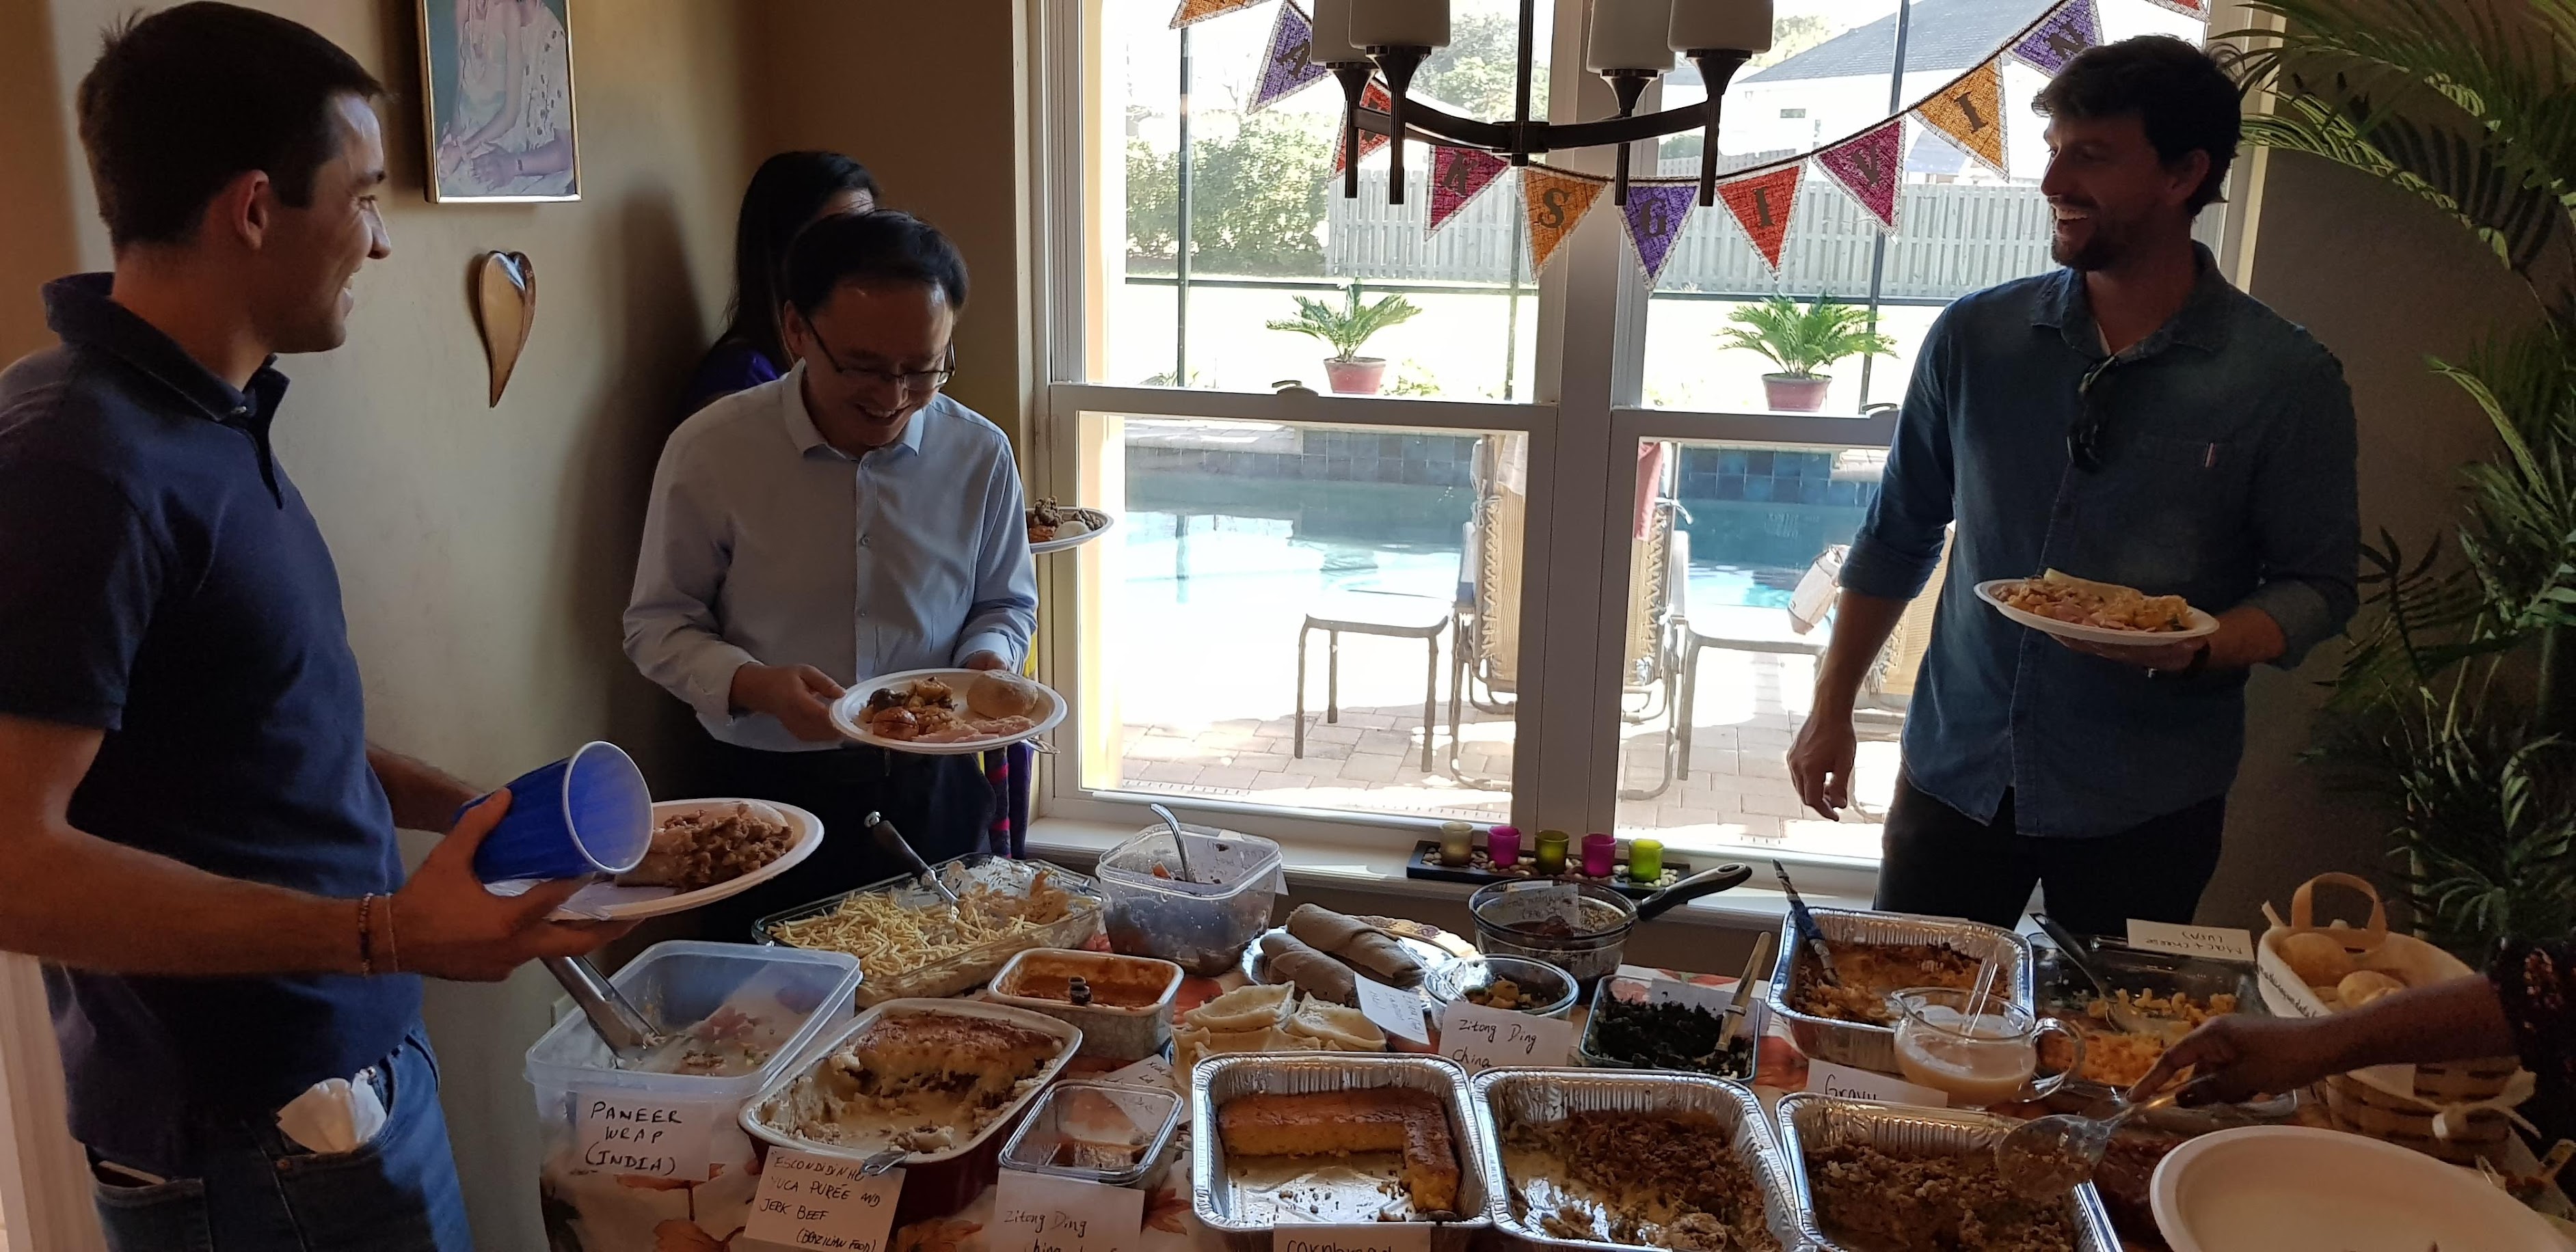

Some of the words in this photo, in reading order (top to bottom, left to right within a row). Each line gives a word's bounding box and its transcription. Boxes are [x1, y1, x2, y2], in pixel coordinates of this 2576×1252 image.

[1459, 1019, 1497, 1043] Zitong
[1507, 1024, 1537, 1054] Ding
[1452, 1046, 1492, 1067] China
[591, 1101, 682, 1124] PANEER
[605, 1126, 663, 1143] WRAP
[585, 1141, 675, 1176] (INDIA)
[759, 1198, 792, 1215] JERK
[796, 1205, 829, 1221] BEEF
[860, 1192, 881, 1208] AND
[1004, 1210, 1045, 1234] Zitong
[1050, 1210, 1087, 1238] Ding
